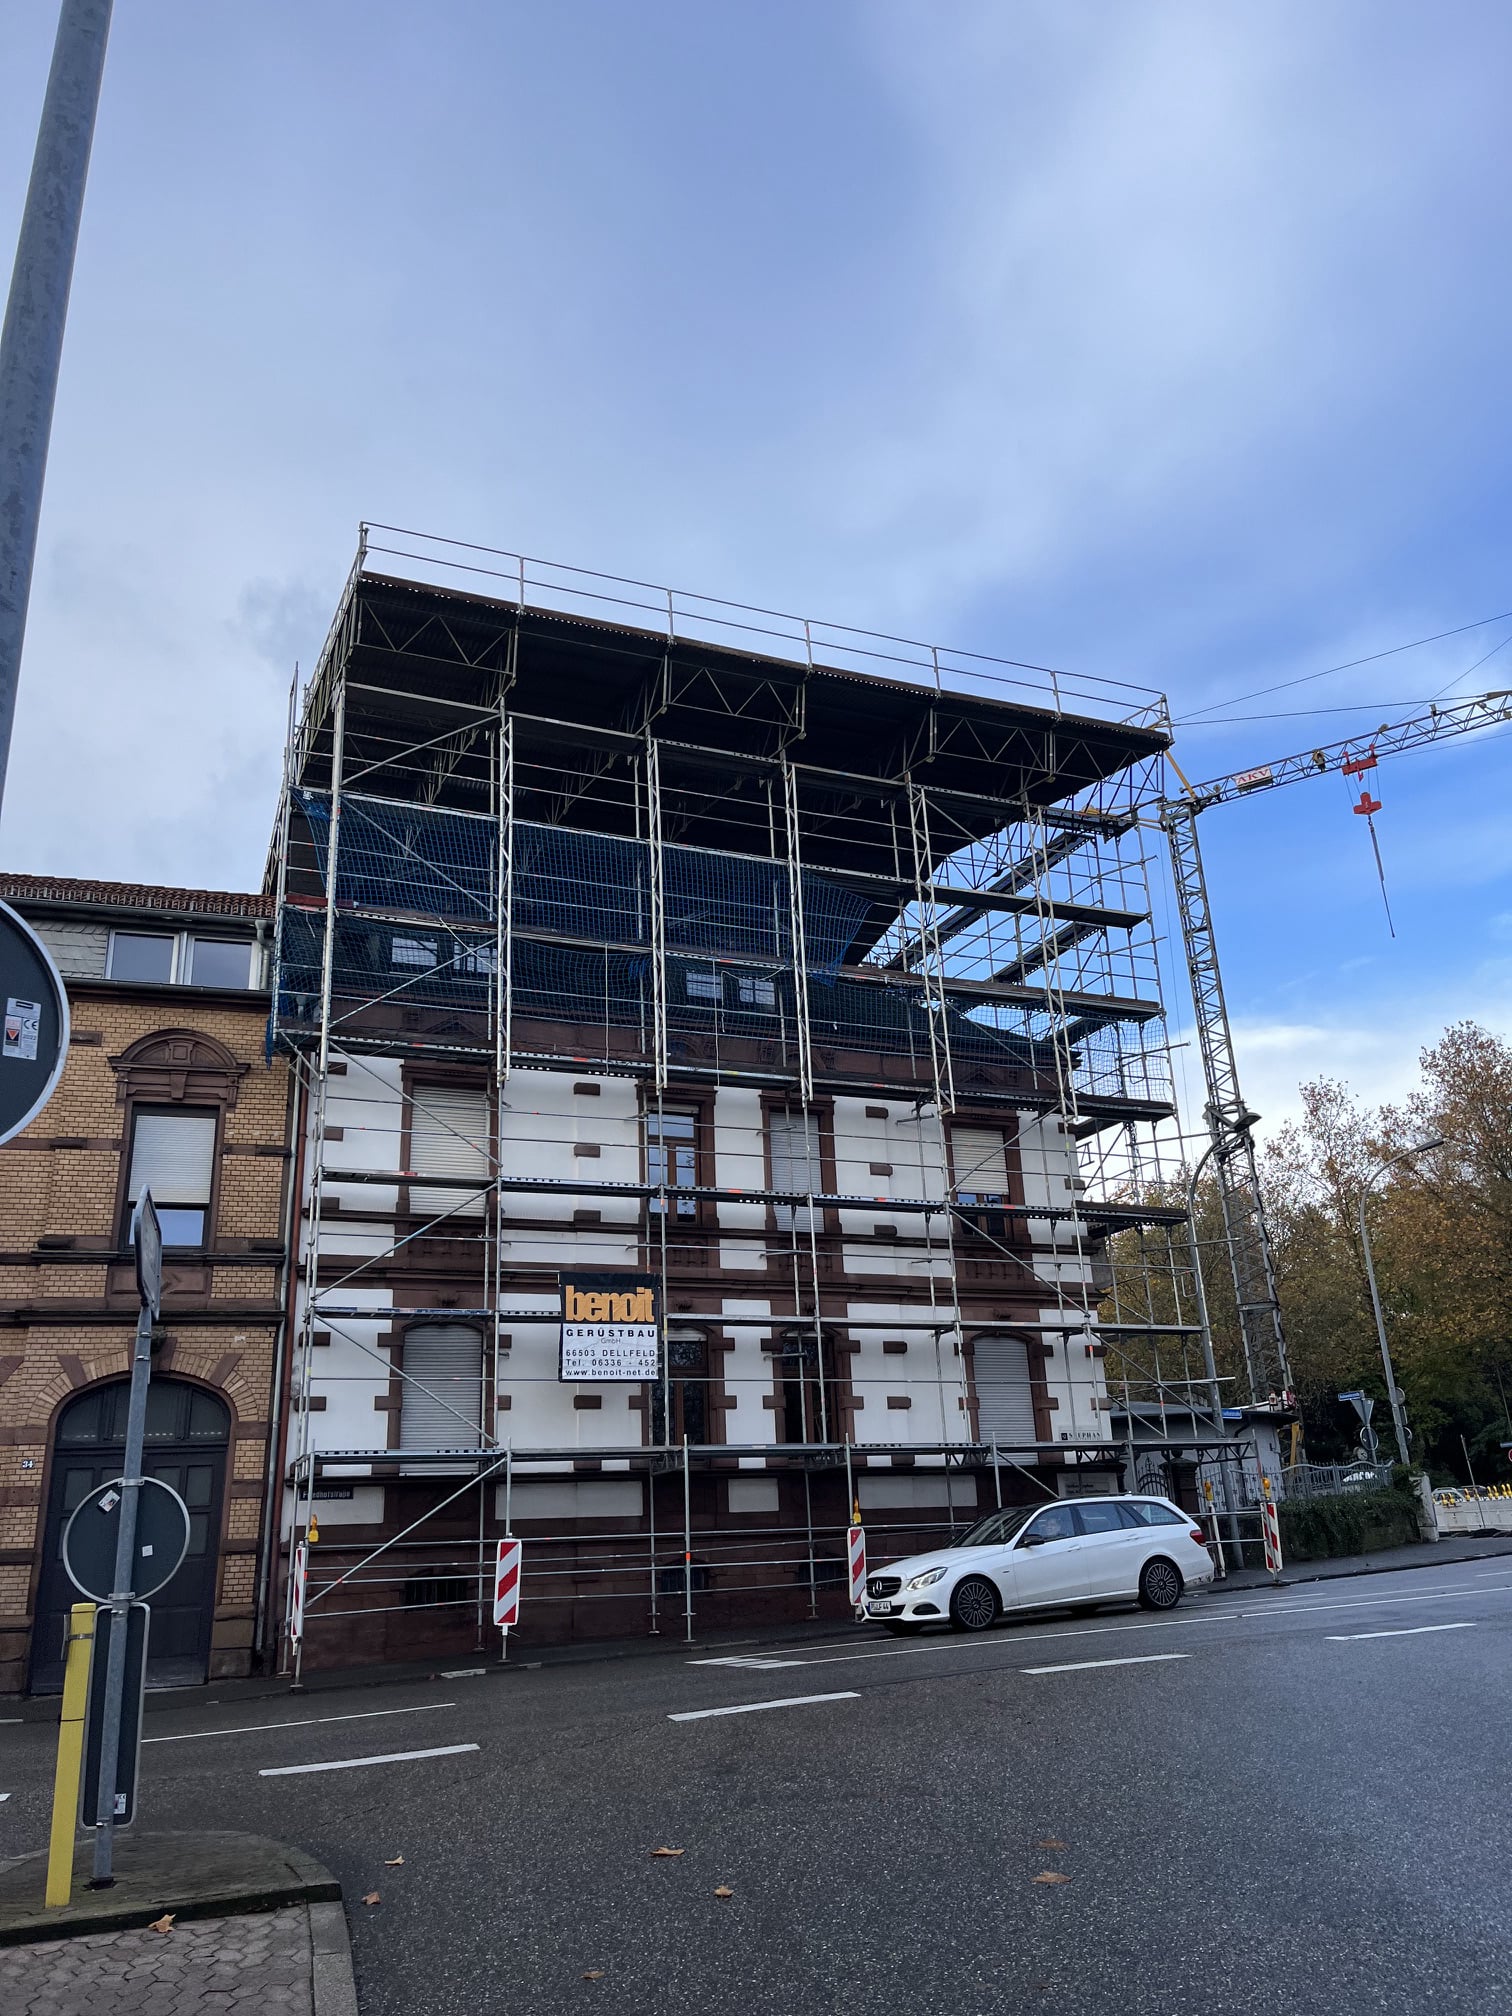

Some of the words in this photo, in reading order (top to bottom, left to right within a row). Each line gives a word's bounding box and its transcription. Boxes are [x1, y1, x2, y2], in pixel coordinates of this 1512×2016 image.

[1238, 769, 1268, 784] AKV
[566, 1285, 654, 1322] benoit
[566, 1328, 654, 1338] GERÜSTBAU
